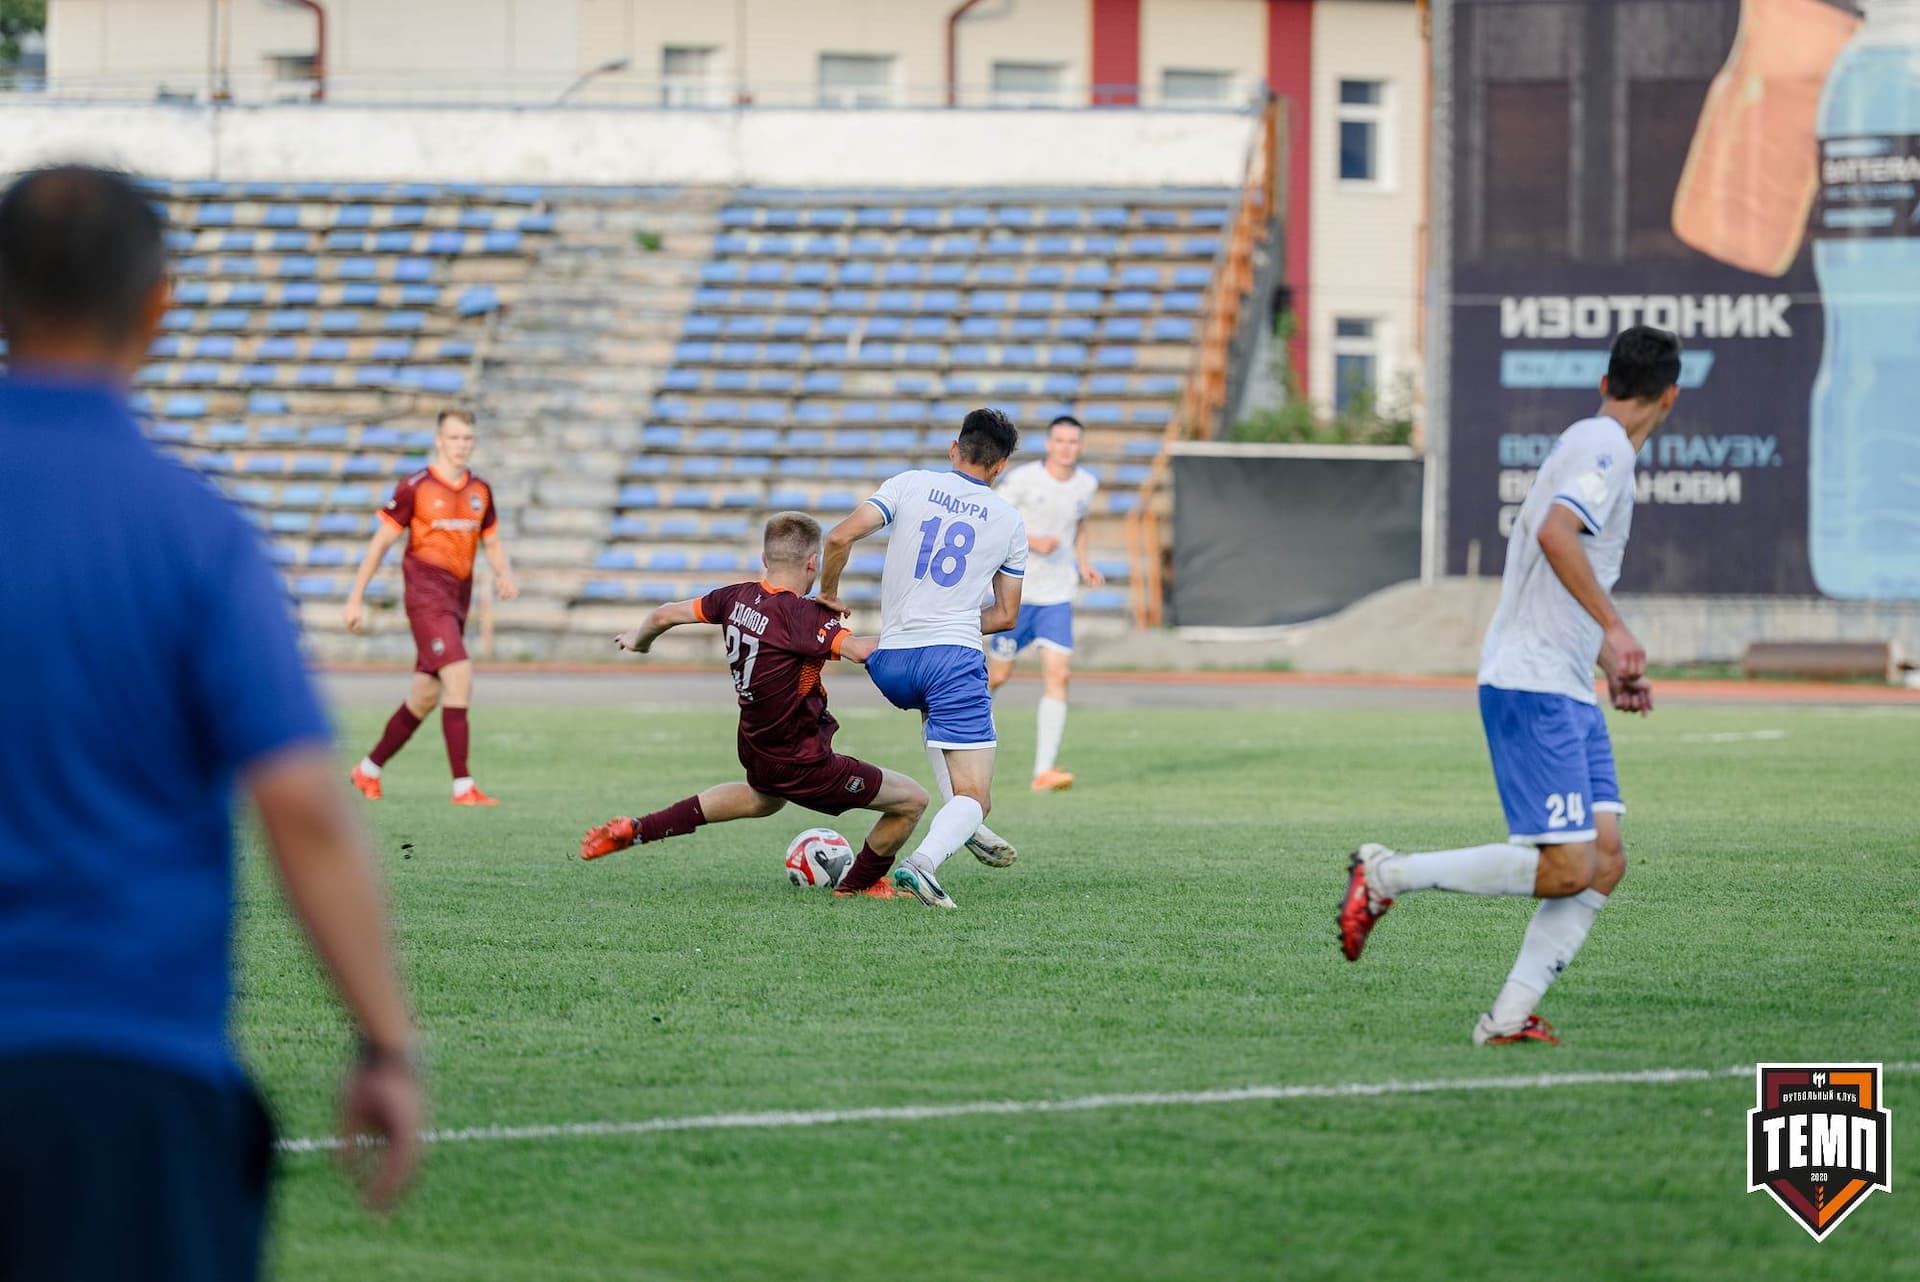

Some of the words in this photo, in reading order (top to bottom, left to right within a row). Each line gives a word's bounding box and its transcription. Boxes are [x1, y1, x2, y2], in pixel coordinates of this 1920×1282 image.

[1501, 294, 1792, 339] ИЗОТОНИК
[928, 488, 988, 521] ШАДУРА
[914, 516, 975, 588] 18
[1545, 791, 1586, 829] 24
